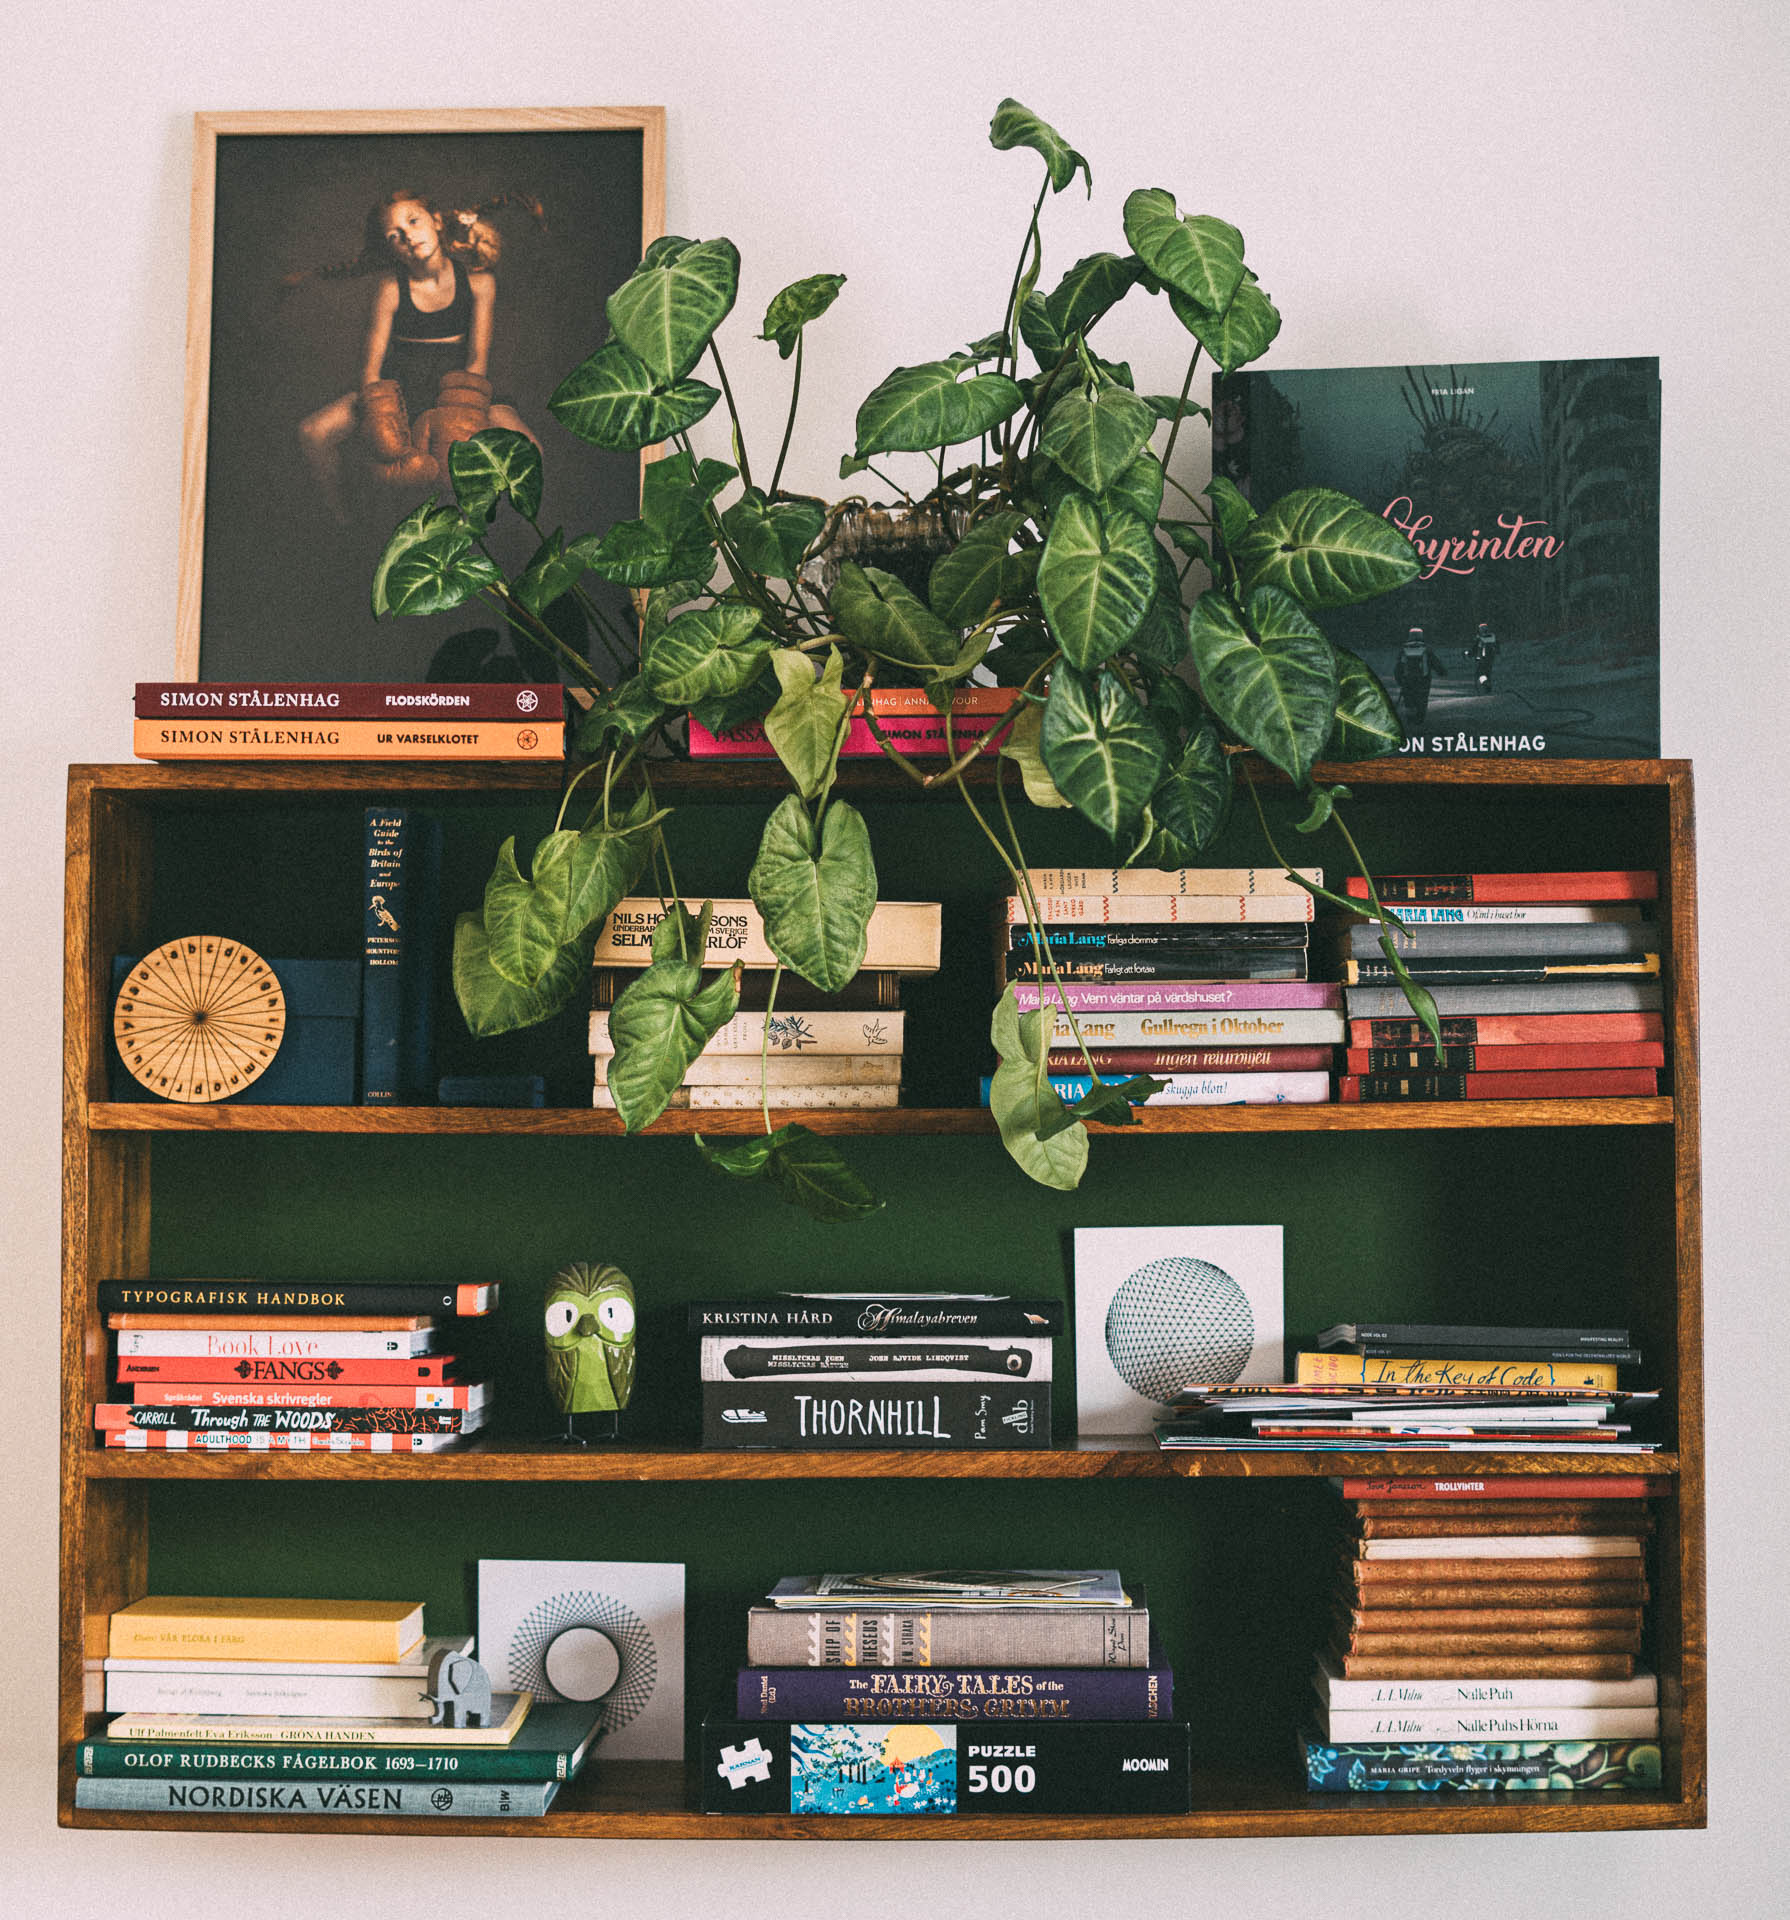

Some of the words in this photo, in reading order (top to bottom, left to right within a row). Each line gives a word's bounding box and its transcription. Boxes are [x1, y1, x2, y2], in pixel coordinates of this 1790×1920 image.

[160, 692, 224, 707] SIMON
[228, 690, 340, 708] STÅLENHAG
[385, 692, 470, 706] FLODSKÖRDEN
[160, 730, 224, 744] SIMON
[229, 728, 340, 745] STÅLENHAG
[377, 734, 392, 744] UR
[396, 734, 480, 744] VARSELKLOTET
[1432, 732, 1546, 752] STÅLENHAG
[370, 818, 376, 827] A
[380, 818, 402, 827] Field
[373, 828, 399, 838] Guide
[368, 848, 390, 856] Birds
[392, 848, 403, 858] of
[370, 860, 400, 868] Britain
[612, 912, 644, 924] NILS
[1396, 908, 1426, 921] ARIA
[1430, 908, 1464, 922] LANG
[612, 924, 656, 932] UNDERBAR
[716, 928, 748, 936] SVERIGE
[612, 934, 653, 946] SELM
[1018, 932, 1066, 946] Maria
[1069, 932, 1106, 948] Lang
[1015, 961, 1065, 976] Maria
[1066, 961, 1104, 977] Lang
[1081, 992, 1108, 1004] Vem
[1110, 992, 1145, 1004] väntar
[1148, 991, 1162, 1007] på
[1164, 990, 1233, 1004] värdshuset?
[1141, 1018, 1207, 1038] Gullregn
[1211, 1018, 1216, 1035] i
[1220, 1018, 1284, 1035] Oktober
[1154, 1052, 1198, 1071] Ingen
[1166, 1084, 1199, 1099] skugga
[122, 1290, 248, 1305] TYPOGRAFISK
[258, 1292, 346, 1306] HANDBOK
[702, 1313, 780, 1325] KRISTINA
[787, 1311, 833, 1324] HÅRD
[857, 1303, 978, 1332] Himalayabreven
[208, 1334, 258, 1355] Book
[269, 1336, 318, 1356] Love
[254, 1361, 325, 1380] FANGS
[1370, 1360, 1396, 1383] In
[1435, 1361, 1474, 1384] Key
[1477, 1366, 1500, 1384] of
[1500, 1366, 1544, 1385] Code
[212, 1392, 264, 1405] Svenska
[266, 1392, 333, 1407] skrivregler
[975, 1395, 991, 1416] Smy
[134, 1411, 176, 1425] CARROLL
[191, 1408, 248, 1430] Through
[253, 1414, 272, 1427] THE
[274, 1410, 336, 1429] WOODS
[794, 1395, 951, 1438] THORNHILL
[974, 1419, 986, 1440] Pam
[196, 1435, 252, 1444] ADULTHOOD
[269, 1436, 276, 1444] A
[1434, 1482, 1484, 1491] TROLLVINTER
[825, 1620, 840, 1632] OF
[902, 1620, 913, 1645] STRAKA
[862, 1620, 878, 1663] THESEUS
[825, 1638, 840, 1663] SHIP
[849, 1680, 868, 1689] The
[870, 1674, 954, 1697] FAIRY
[957, 1674, 1033, 1695] TALES
[1036, 1681, 1048, 1690] of
[1048, 1681, 1064, 1690] the
[1148, 1675, 1158, 1718] TASCHEN
[1458, 1688, 1488, 1700] Nalle
[1489, 1688, 1513, 1700] Puh
[843, 1697, 978, 1719] BROTHERS
[984, 1699, 1071, 1718] GRIMM
[130, 1728, 145, 1737] Ulf
[148, 1728, 203, 1738] Palmenfelt
[206, 1729, 224, 1738] Eva
[228, 1729, 273, 1738] Eriksson
[1458, 1720, 1488, 1732] Nalle
[1489, 1720, 1518, 1731] Puhs
[1520, 1718, 1559, 1731] Hörna
[325, 1731, 375, 1740] HANDEN
[968, 1745, 1036, 1757] PUZZLE
[124, 1753, 173, 1768] OLOF
[179, 1754, 275, 1768] RUDBECKS
[282, 1753, 377, 1769] FÅGELBOK
[1122, 1758, 1168, 1772] MOOMIN
[1425, 1765, 1464, 1774] Tordyveln
[1466, 1765, 1488, 1775] flyger
[1494, 1765, 1540, 1776] skymningen
[968, 1766, 1036, 1793] 500
[168, 1785, 306, 1808] NORDISKA
[317, 1784, 402, 1810] VÄSEN
